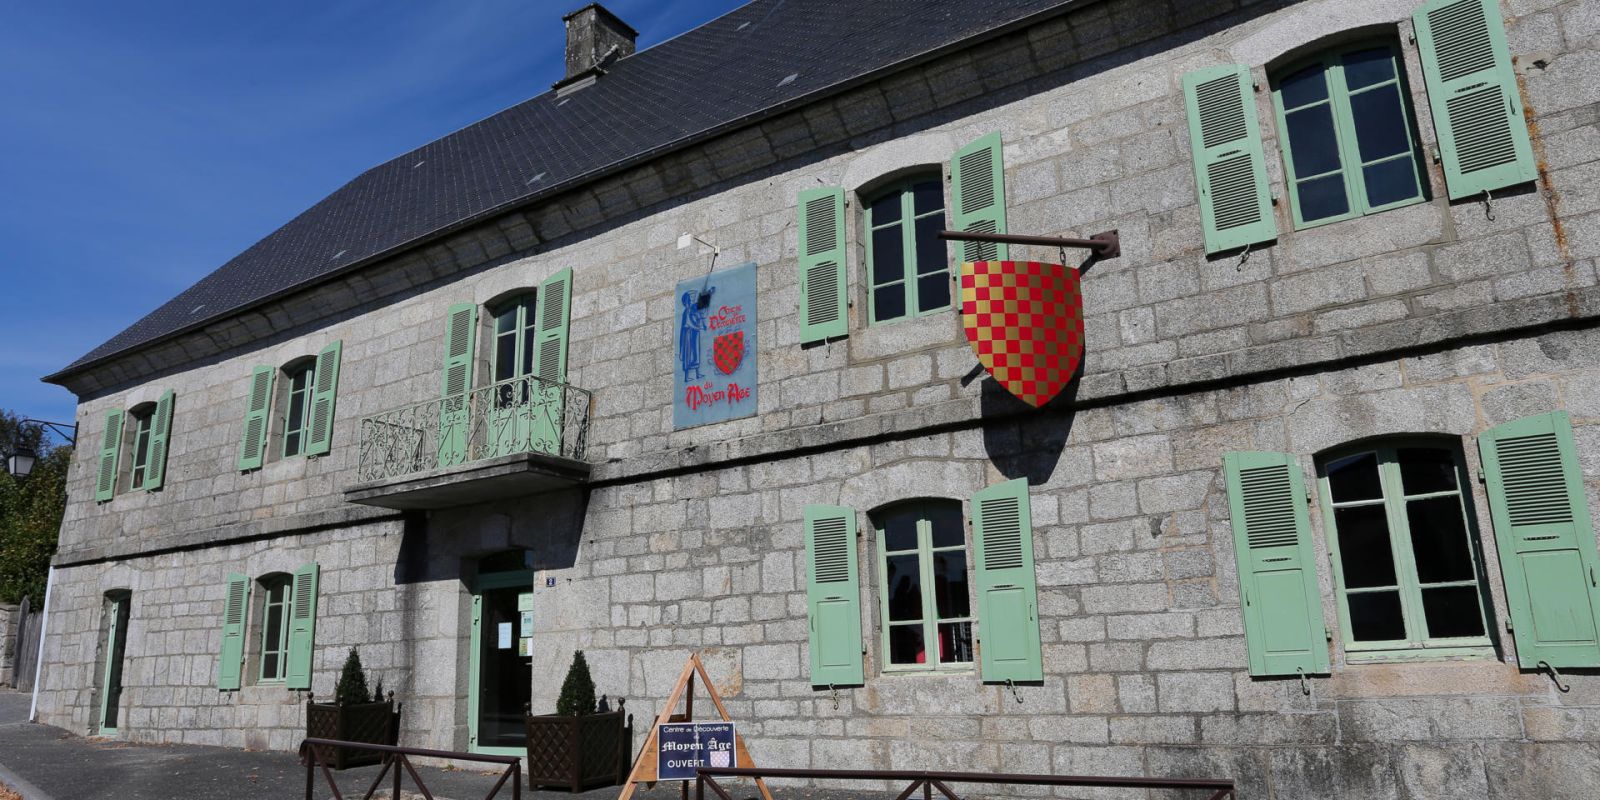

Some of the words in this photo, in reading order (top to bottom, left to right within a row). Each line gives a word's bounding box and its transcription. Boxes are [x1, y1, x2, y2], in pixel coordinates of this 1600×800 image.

[661, 741, 704, 752] Moyen
[707, 737, 732, 751] Âge
[667, 759, 705, 768] OUVERT
